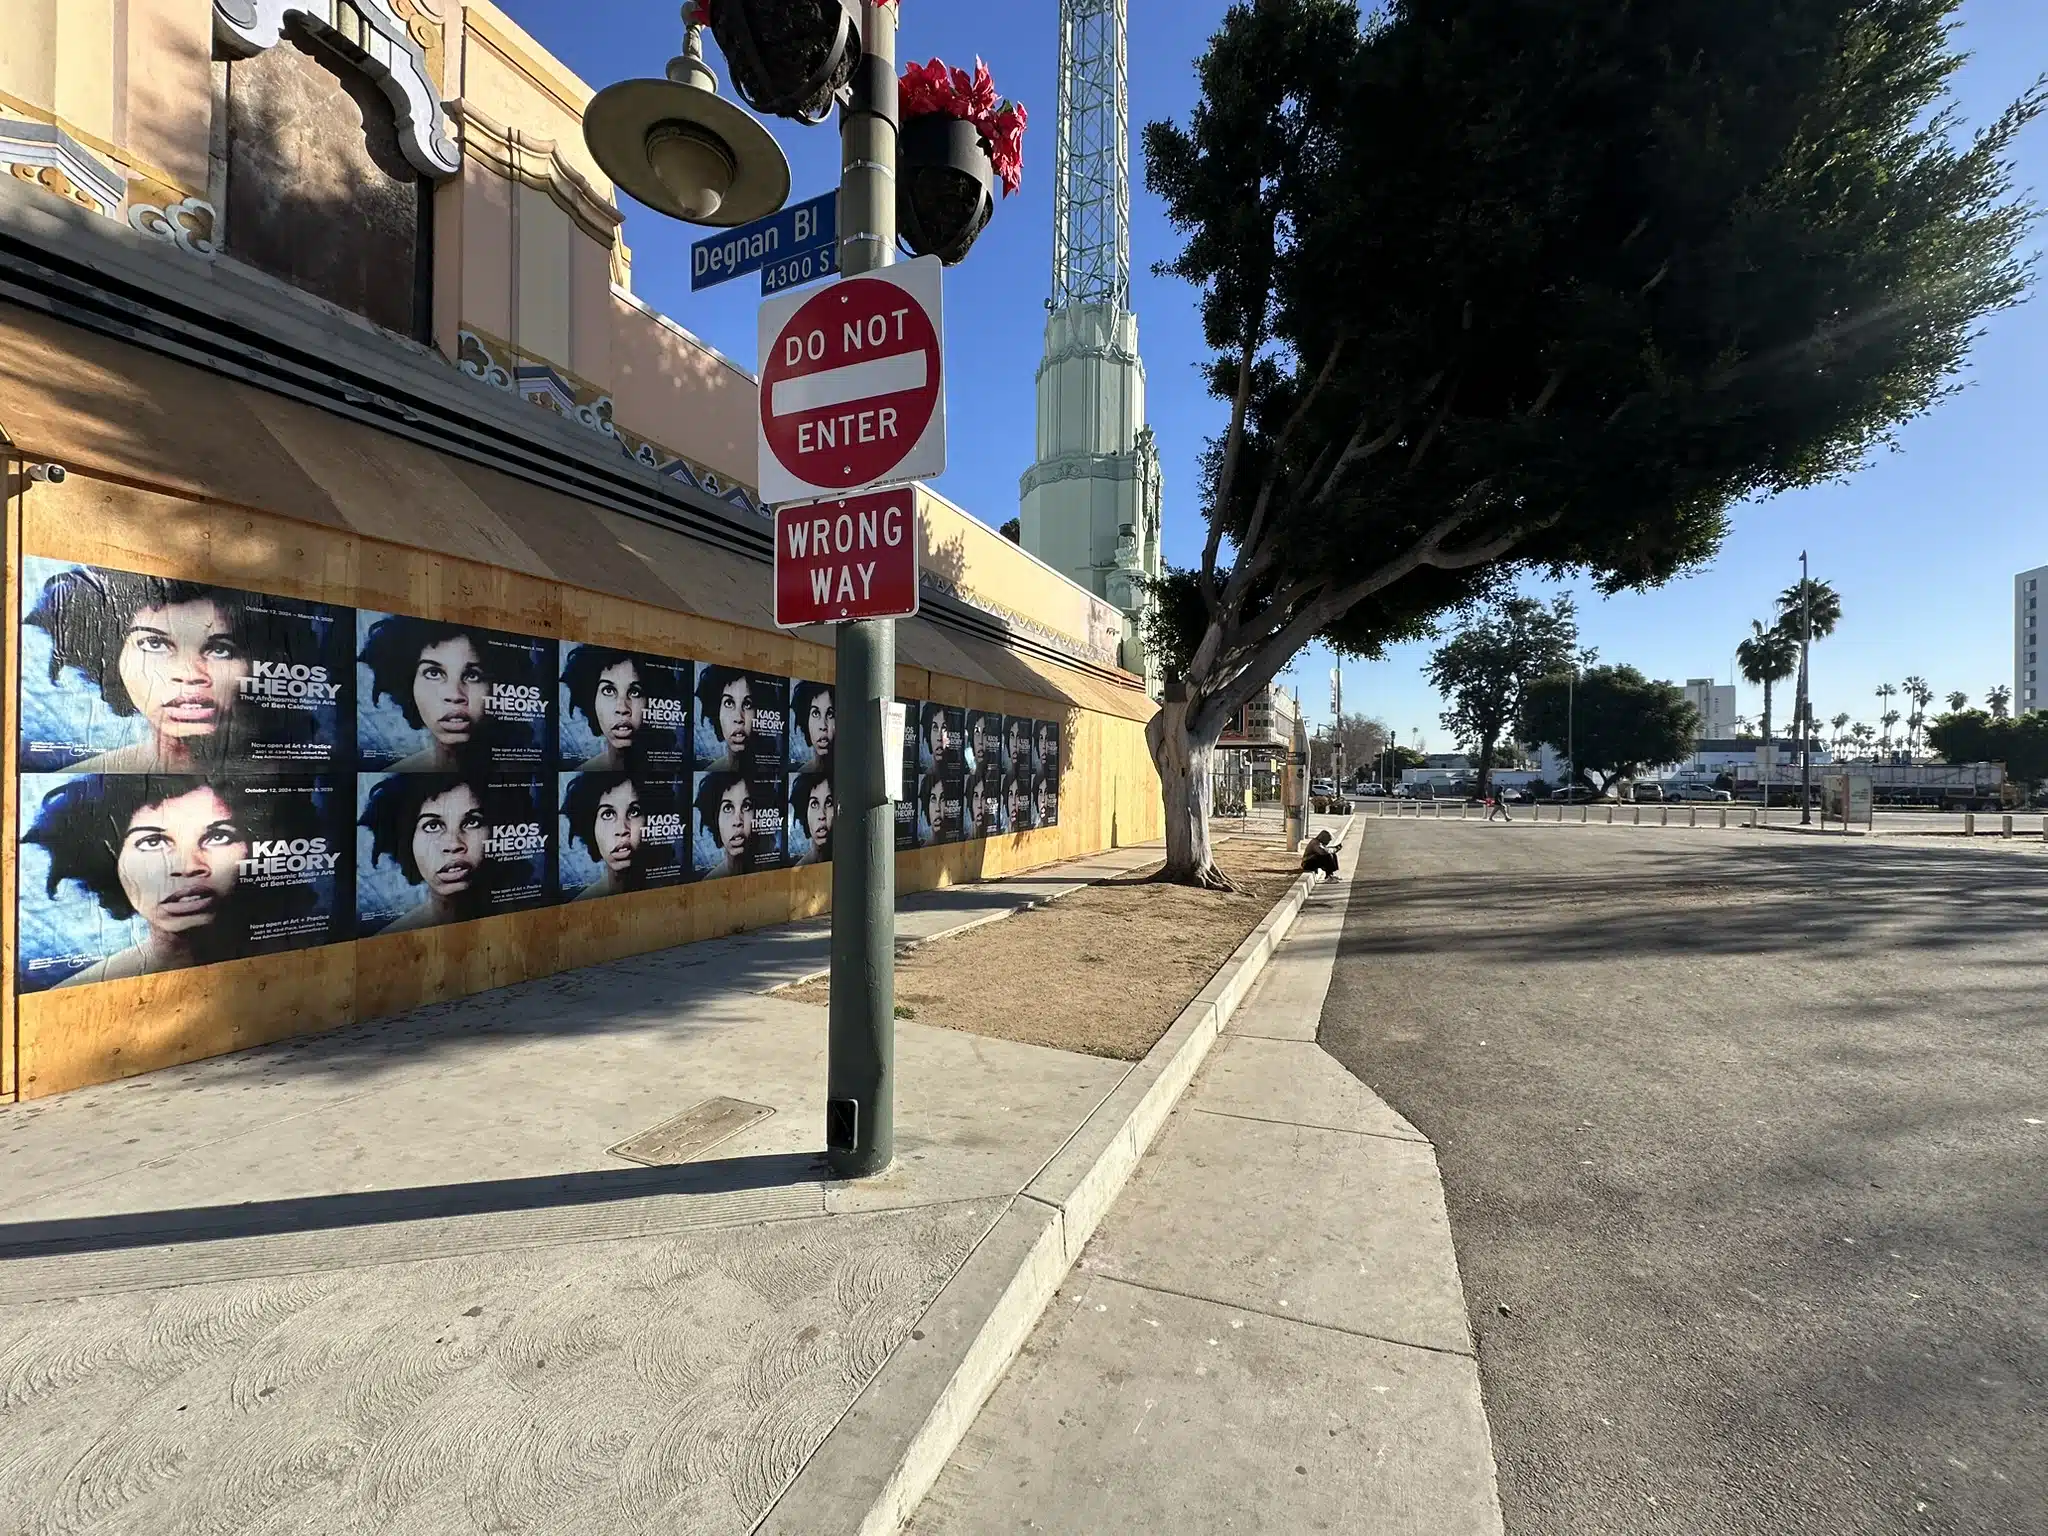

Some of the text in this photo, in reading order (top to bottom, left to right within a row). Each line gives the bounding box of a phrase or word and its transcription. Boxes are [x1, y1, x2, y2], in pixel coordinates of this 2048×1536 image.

[695, 205, 817, 277] Degnan Bl
[765, 250, 830, 289] 4300 S
[786, 308, 909, 367] DO NOT
[798, 407, 898, 454] ENTER
[787, 506, 902, 559] WRONG
[810, 561, 876, 605] WAY
[246, 605, 268, 613] October
[252, 660, 327, 682] KAOS
[234, 676, 342, 699] THEORY
[492, 683, 540, 700] KAOS
[481, 695, 549, 713] THEORY
[648, 697, 681, 711] KAOS
[641, 708, 688, 722] THEORY
[756, 709, 781, 721] KAOS
[751, 718, 785, 731] THEORY
[647, 813, 680, 827] KAOS
[755, 808, 780, 819] KAOS
[492, 823, 540, 839] KAOS
[640, 823, 687, 838] THEORY
[751, 816, 784, 829] THEORY
[252, 837, 327, 858] KAOS
[482, 834, 549, 853] THEORY
[235, 852, 341, 876] THEORY
[255, 874, 297, 882] Afrokosmic
